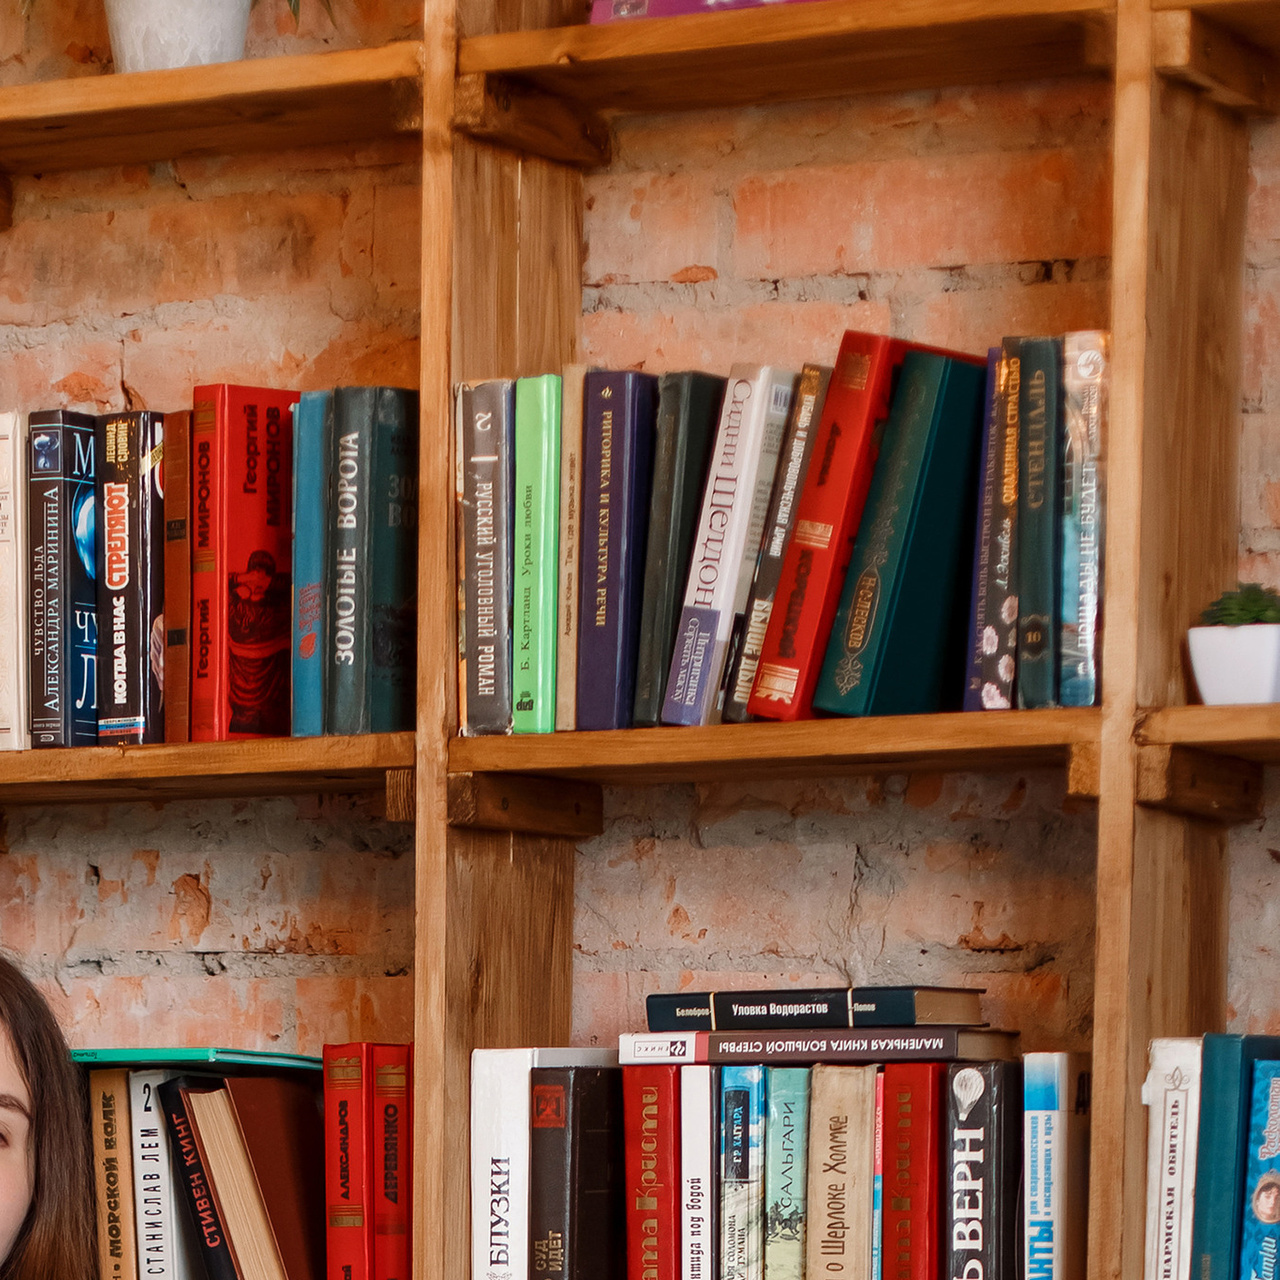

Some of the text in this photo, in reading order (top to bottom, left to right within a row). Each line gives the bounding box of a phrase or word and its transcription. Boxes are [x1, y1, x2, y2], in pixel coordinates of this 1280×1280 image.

[106, 424, 116, 463] ЛЕОНИД
[117, 422, 129, 463] СЛОВИН
[243, 405, 258, 494] Георгий
[266, 407, 280, 527] МИРОНОВ
[1002, 356, 1020, 506] ОПАЛЕННАЯ СТРАСТЬЮ
[1027, 369, 1047, 509] СТЕНДАЛЬ
[43, 486, 59, 590] МАРИНИНА
[104, 482, 130, 591] СТРЕЛЯЮТ
[476, 482, 494, 547] РУССКИЙ
[595, 411, 613, 627] РИТОРИКА И КУЛЬТУРА РЕЧИ
[693, 378, 752, 609] Сидни Шелдон
[197, 442, 211, 679] Георгий МИРОНОВ
[335, 431, 360, 666] ЗОЛОТЫЕ ВОРОТА
[476, 551, 496, 638] УГОЛОВНЫЙ
[520, 485, 533, 671] Б. Картланд Уроки любви
[34, 545, 45, 656] ЧУВСТВО ЛЬДА
[114, 595, 126, 623] НАС
[43, 596, 60, 712] АЛЕКСАНДРА
[114, 645, 127, 704] КОГДА
[478, 644, 495, 695] РОМАН
[684, 630, 710, 706] Интриганка
[719, 1037, 945, 1056] МАЛЕНЬКАЯ КНИГА БОЛЬШОЙ СТЕРВЫ
[104, 1090, 117, 1150] ВОЛК
[142, 1083, 152, 1113] 2
[635, 1085, 665, 1212] Кристи
[1167, 1099, 1180, 1177] ОБИТЕЛЬ
[172, 1113, 221, 1249] СТИВЕН КИНГ
[341, 1099, 351, 1200] АЛЕКСАНДРОВ
[383, 1103, 399, 1205] ДЕРЕВЯНКО
[686, 1177, 703, 1213] водой
[780, 1101, 796, 1208] САЛЬГАРИ
[952, 1127, 985, 1252] ВЕРН
[104, 1156, 124, 1261] МОРСКОЙ
[140, 1128, 165, 1275] СТАНИСЛАВ ЛЕМ
[489, 1156, 511, 1267] БЛУЗКИ
[535, 1230, 562, 1272] СУД ИДЕТ
[693, 1218, 702, 1238] под
[729, 1213, 737, 1262] СОЛОМОНА
[738, 1226, 747, 1266] ТУМАНА
[821, 1182, 851, 1256] Шерлоке
[1162, 1186, 1176, 1280] ПАРМСКАЯ
[826, 1261, 837, 1272] о
